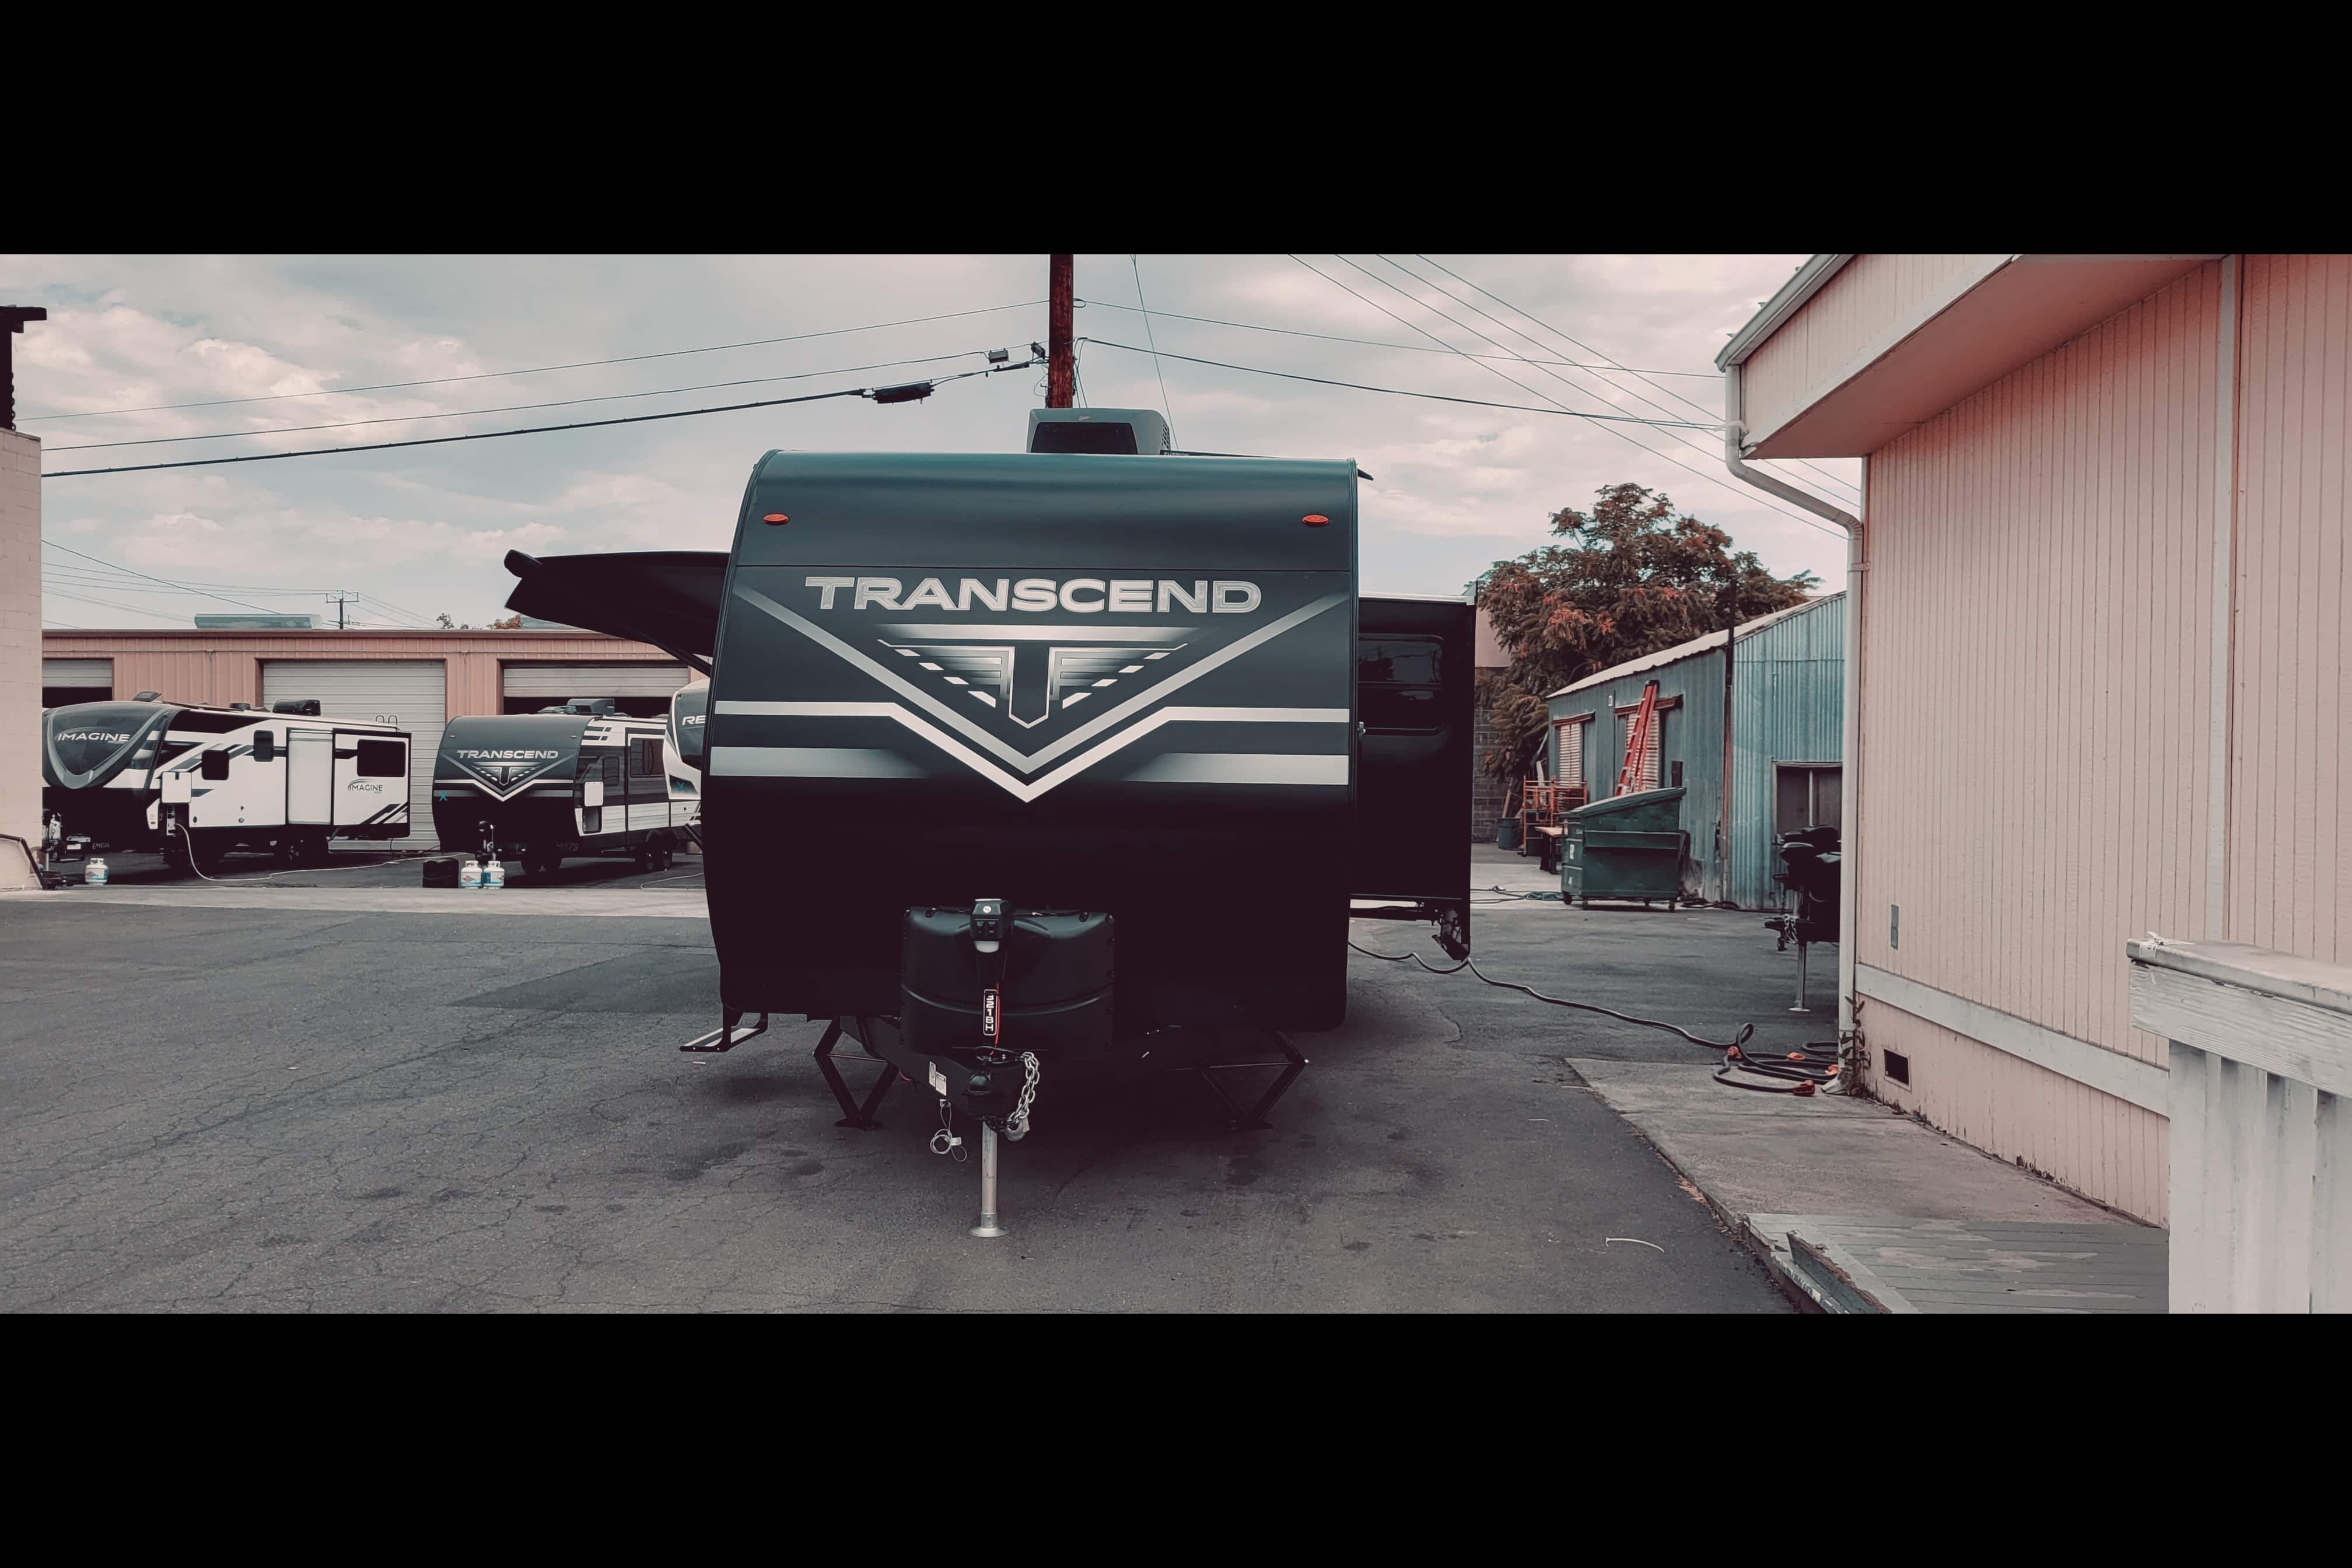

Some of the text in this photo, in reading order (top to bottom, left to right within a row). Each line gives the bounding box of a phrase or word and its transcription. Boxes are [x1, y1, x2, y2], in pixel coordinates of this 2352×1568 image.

[805, 576, 1262, 613] TRANSCEND
[58, 732, 130, 741] IMAGINE
[457, 750, 558, 759] TRANSCEND
